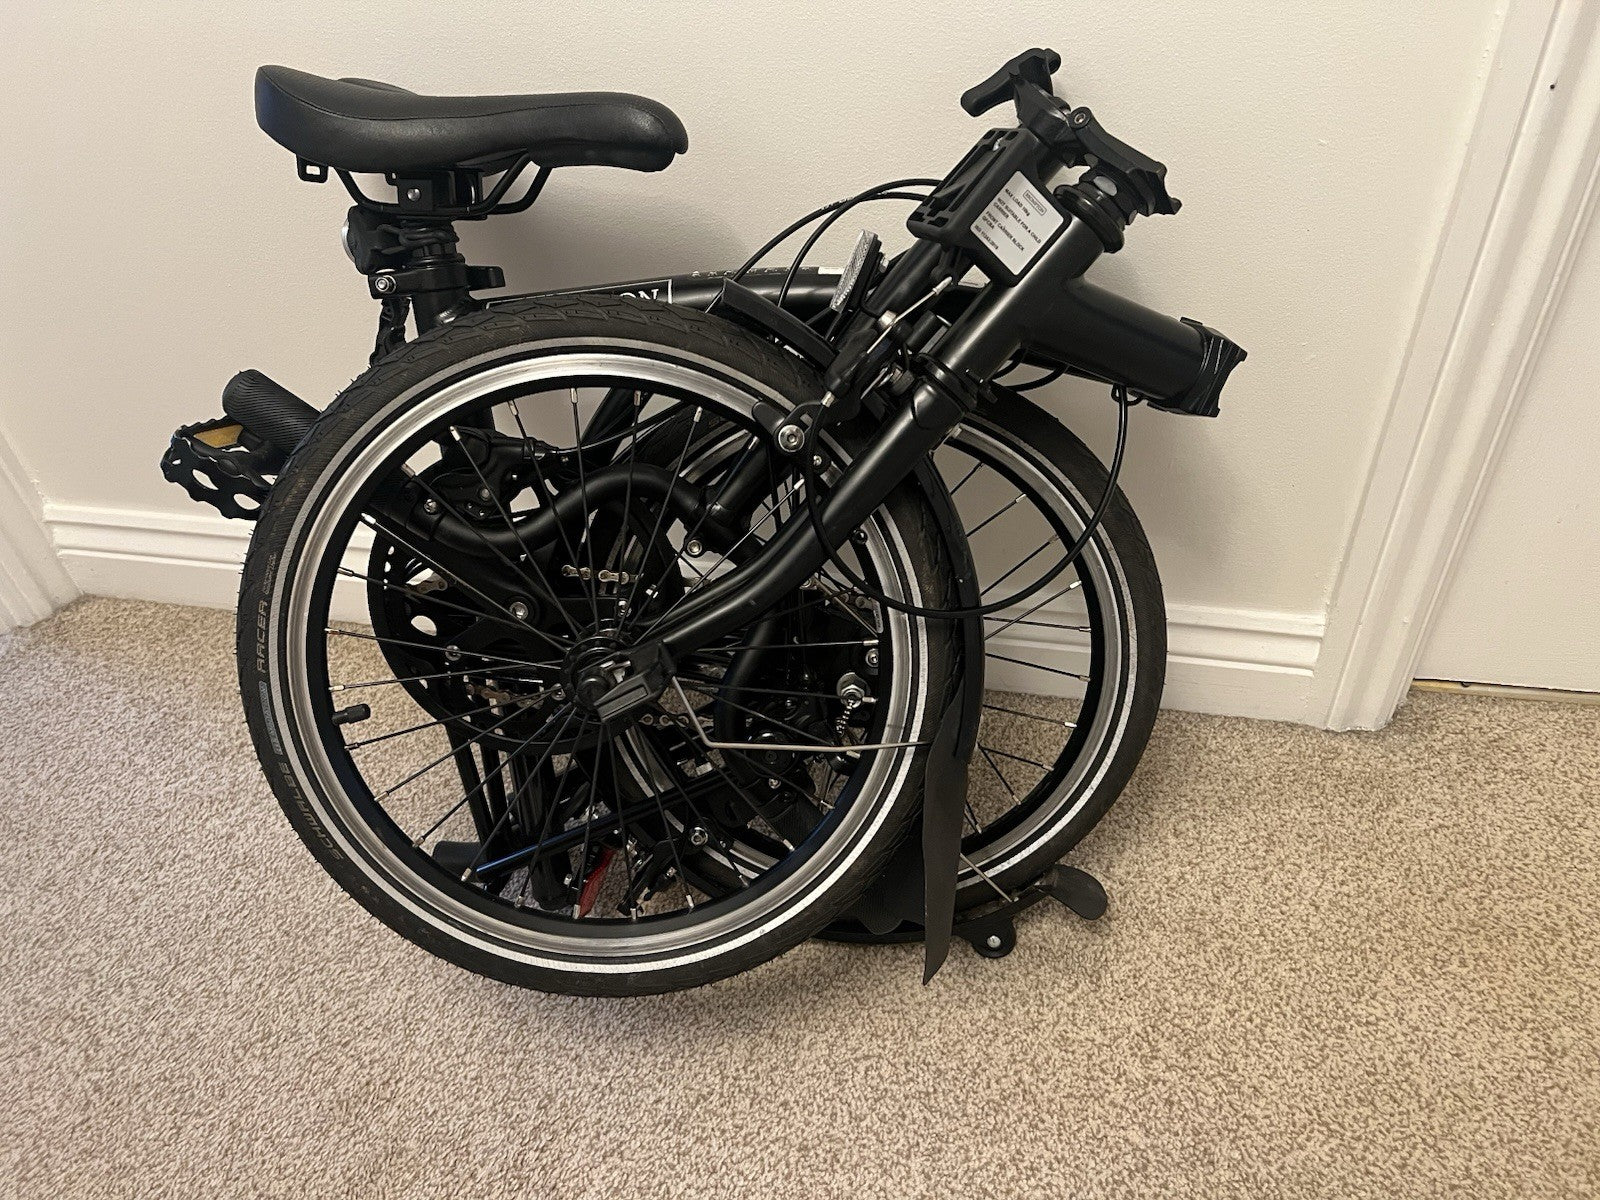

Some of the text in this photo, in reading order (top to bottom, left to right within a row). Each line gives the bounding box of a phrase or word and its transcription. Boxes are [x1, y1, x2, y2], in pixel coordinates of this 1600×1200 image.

[993, 202, 1010, 219] CARRIER
[1005, 188, 1013, 198] MAX
[1013, 196, 1023, 208] LOAD
[986, 211, 1025, 251] FRONT CARRIER BLOCK
[997, 197, 1005, 207] NOT
[1004, 205, 1022, 224] SUITABLE
[1020, 221, 1029, 231] FOR
[1030, 232, 1042, 244] CHILD
[256, 600, 267, 673] RACER
[278, 761, 344, 860] SCHWALBE
